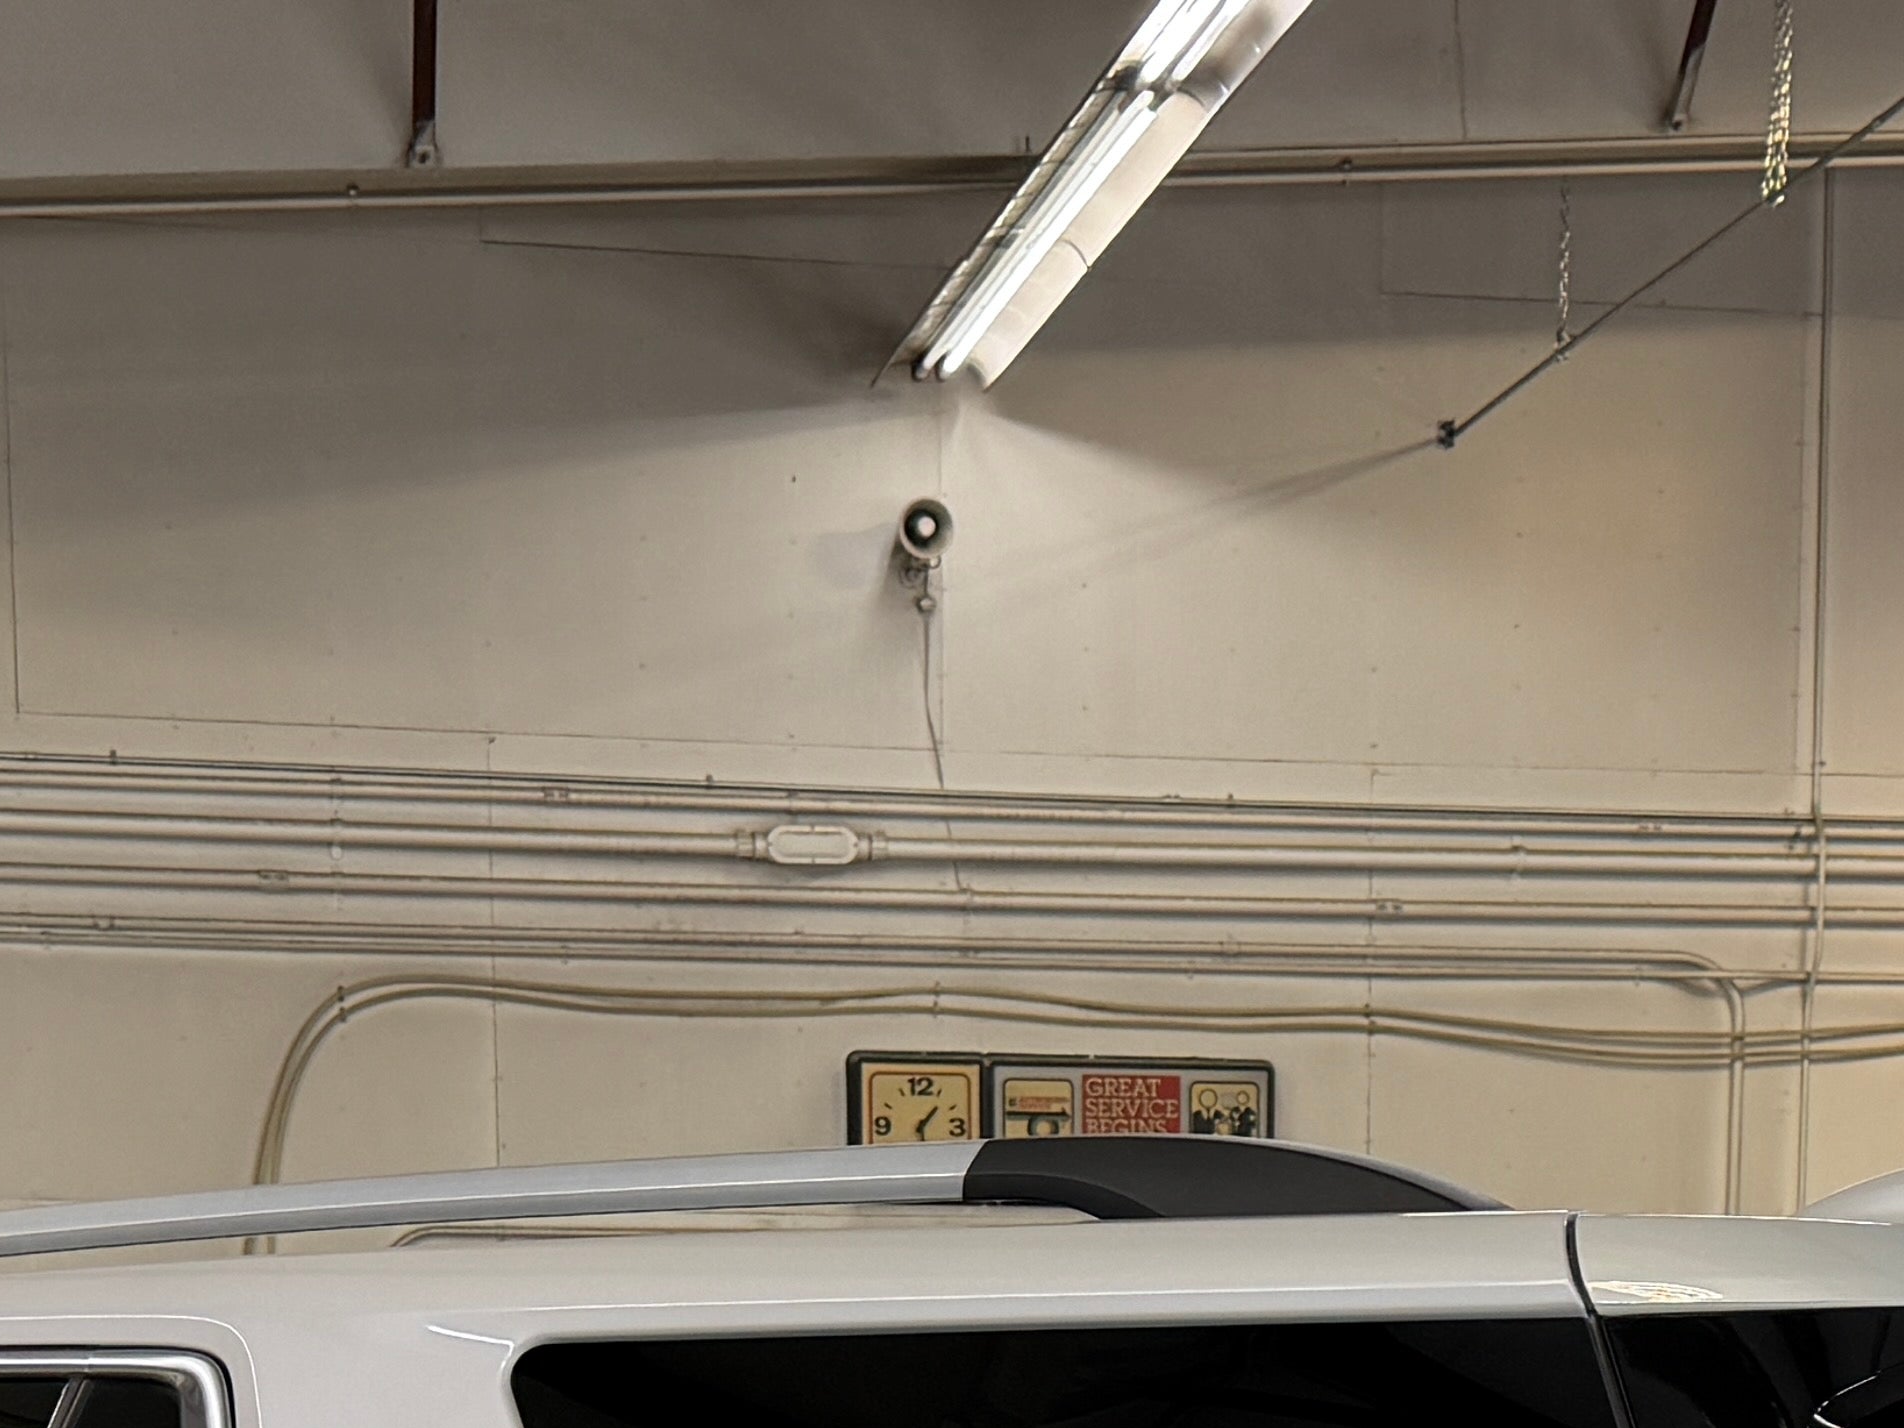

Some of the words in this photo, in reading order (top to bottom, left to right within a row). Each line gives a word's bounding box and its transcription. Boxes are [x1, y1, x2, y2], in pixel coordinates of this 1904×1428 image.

[907, 1077, 934, 1097] 12
[1085, 1077, 1161, 1098] GREAT
[1085, 1098, 1179, 1119] SERVICE
[874, 1116, 892, 1136] 9
[948, 1117, 967, 1137] 3
[1085, 1118, 1167, 1133] BEGINS
